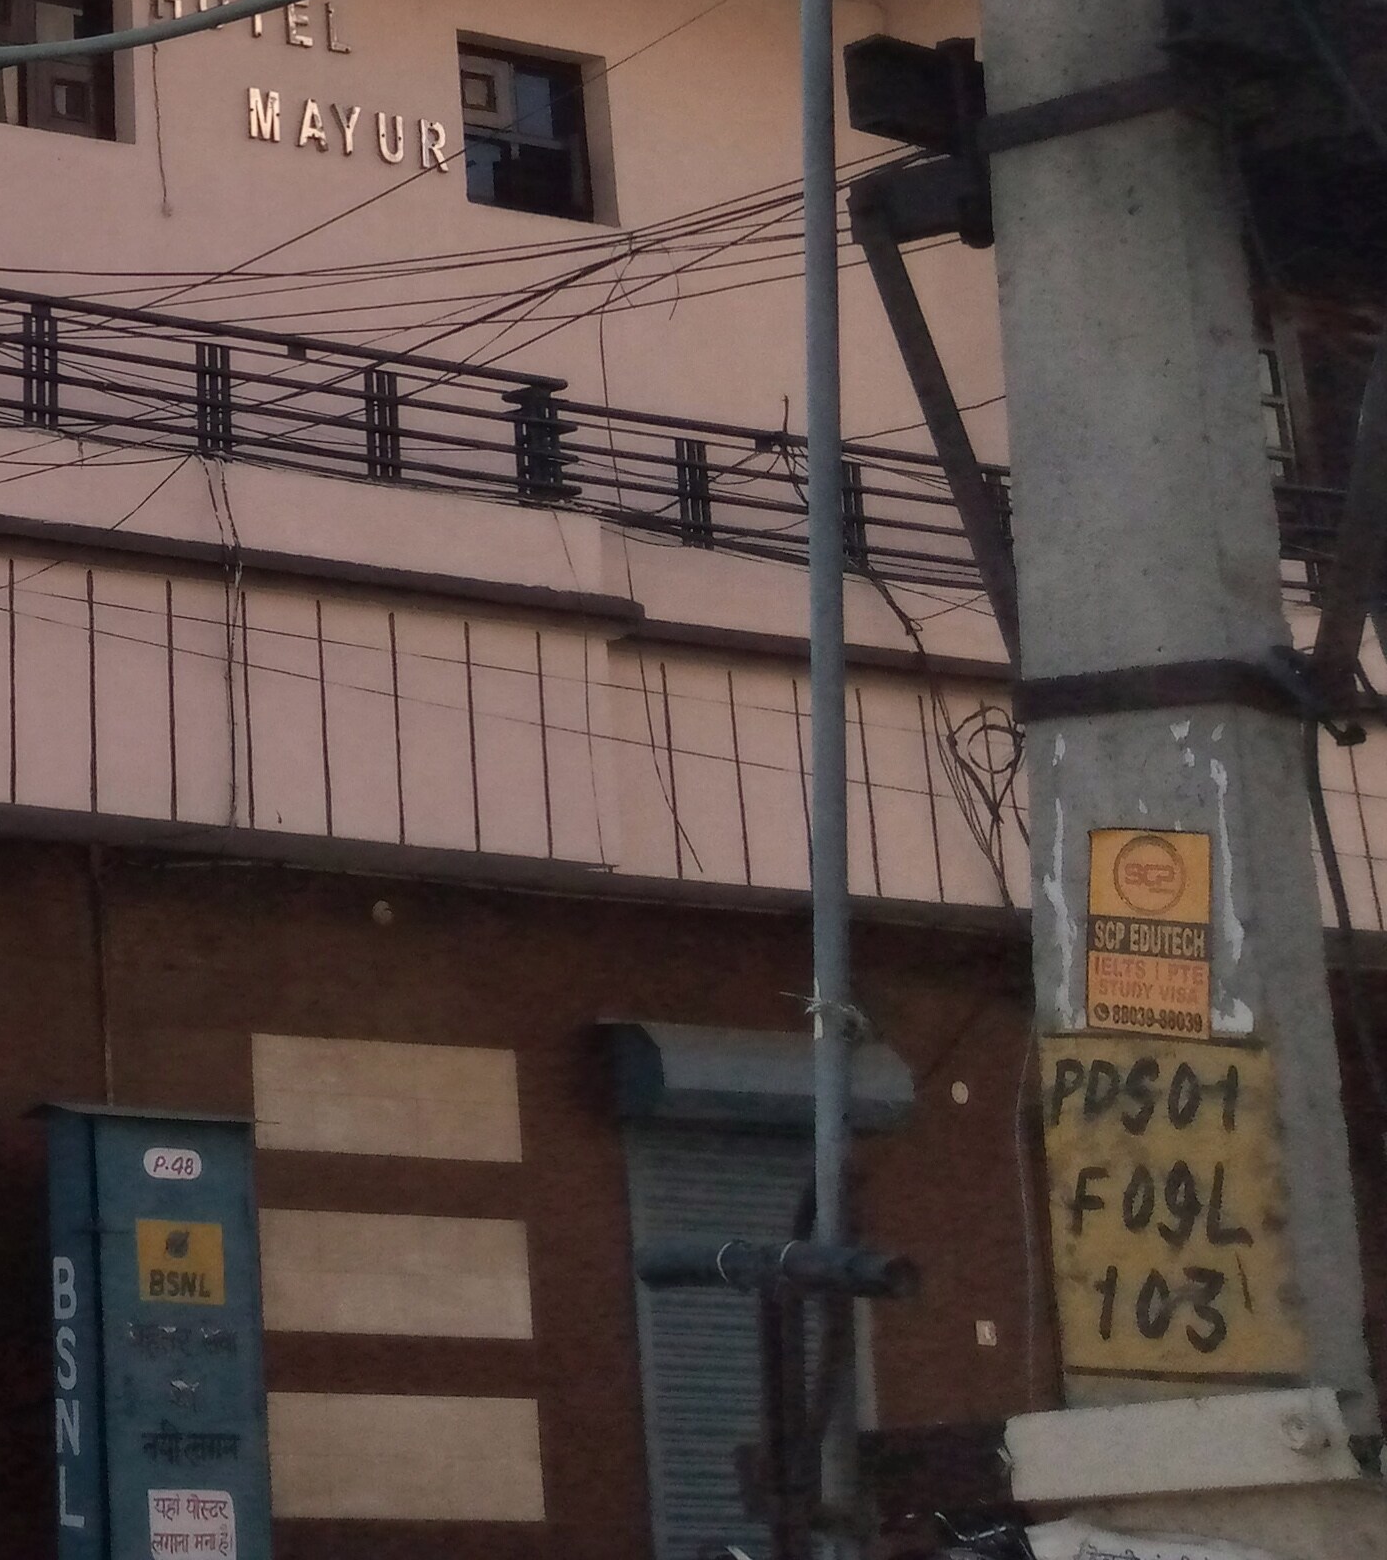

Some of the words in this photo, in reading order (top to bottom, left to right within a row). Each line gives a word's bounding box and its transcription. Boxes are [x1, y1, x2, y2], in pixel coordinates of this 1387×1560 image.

[247, 86, 450, 174] MAYUR
[1094, 919, 1125, 951] SCP
[1129, 923, 1206, 958] EDUTECH
[1094, 956, 1146, 980] IELTS
[1167, 965, 1204, 986] PTE
[1098, 979, 1153, 1000] STUDY
[1158, 985, 1199, 1006] VISA
[149, 1269, 211, 1299] BSNL
[1093, 1265, 1228, 1354] 103
[52, 1256, 85, 1529] BSNL
